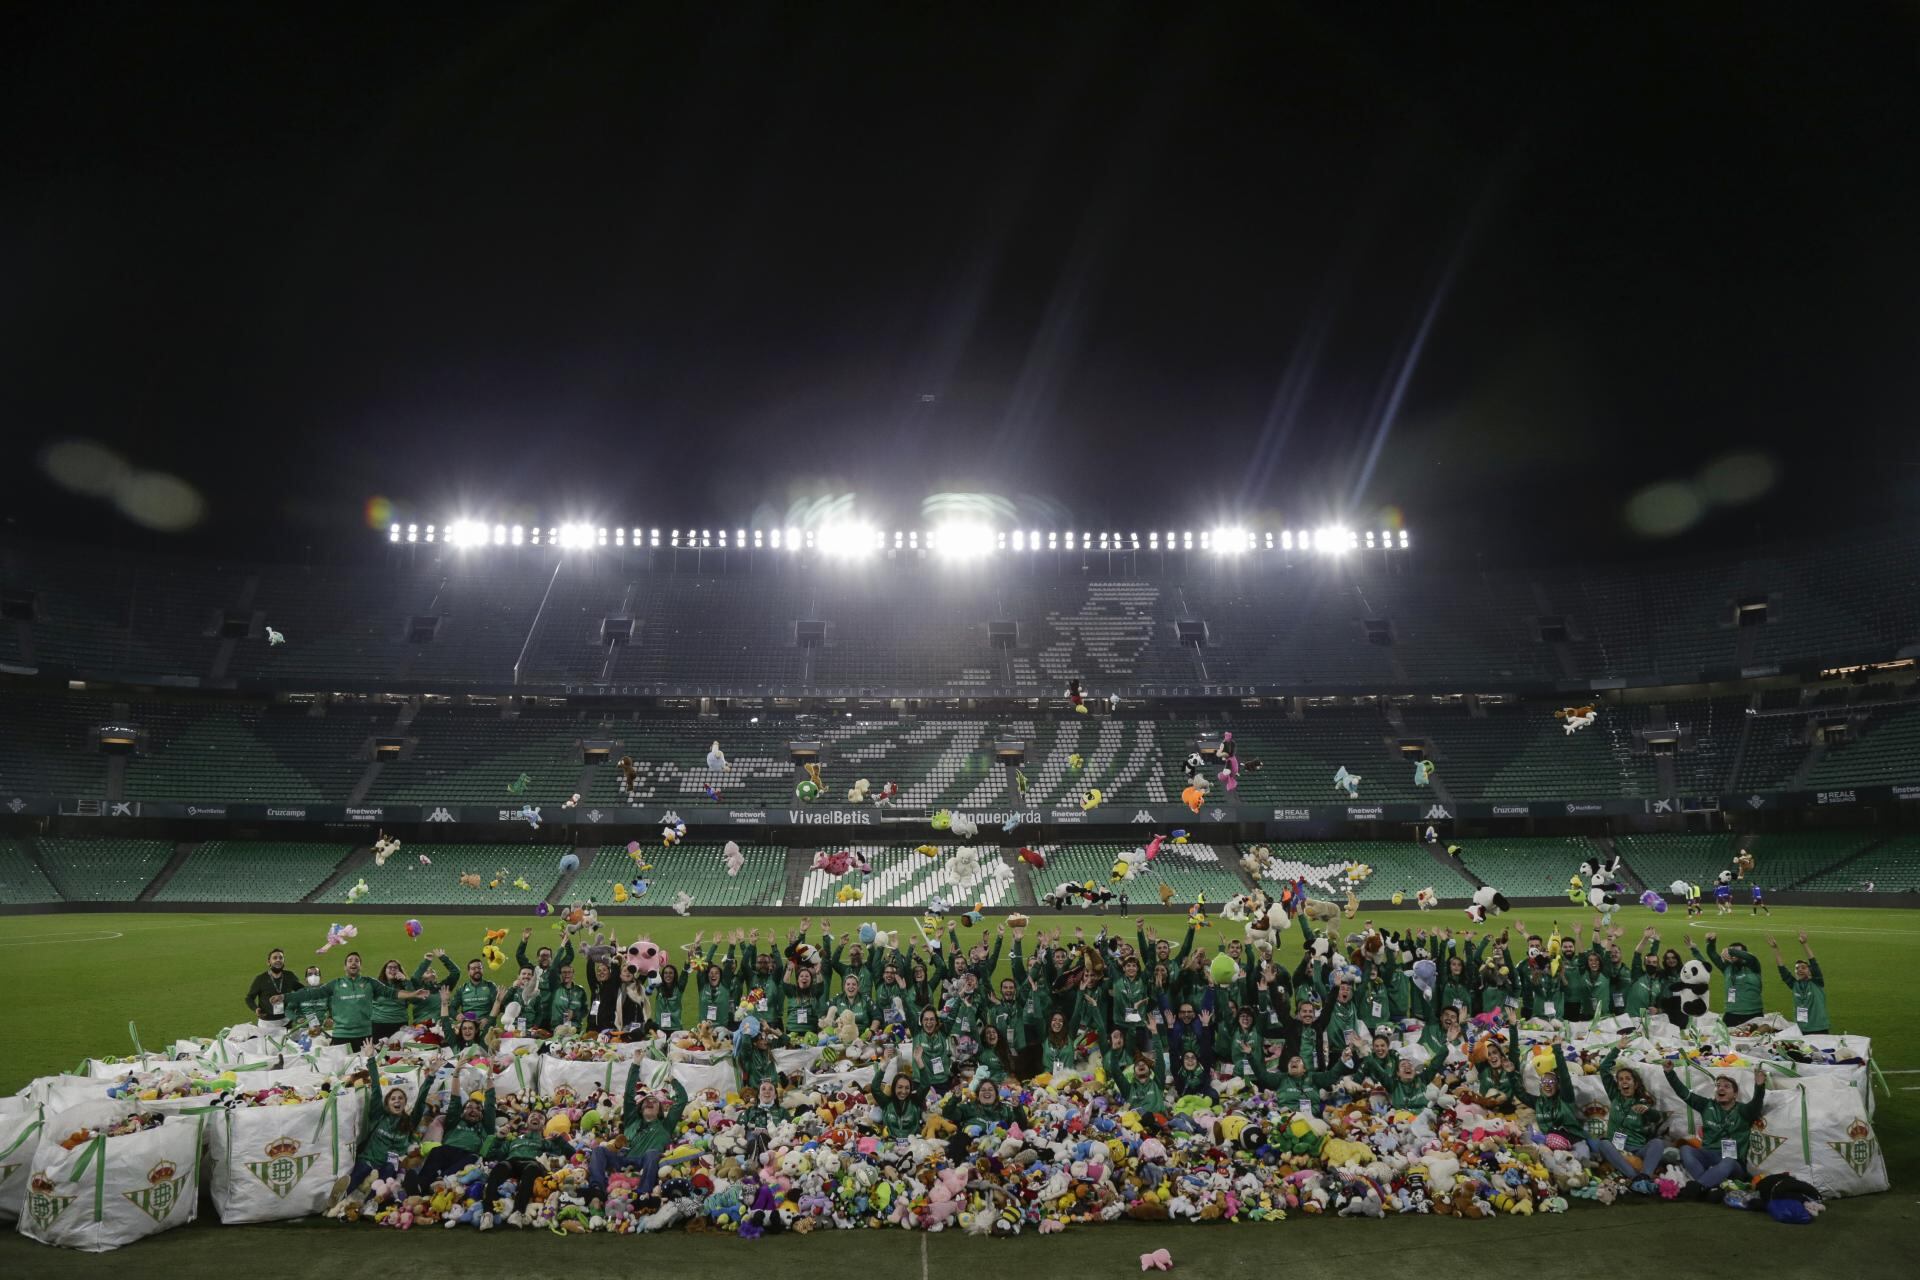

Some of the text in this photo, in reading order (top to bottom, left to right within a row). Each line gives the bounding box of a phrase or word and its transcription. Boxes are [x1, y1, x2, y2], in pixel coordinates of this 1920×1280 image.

[1204, 686, 1256, 695] BETIS
[267, 808, 305, 817] Cruzcampo
[346, 807, 383, 815] finetwork
[1348, 807, 1384, 815] finetwork
[1492, 806, 1530, 815] Cruzcampo
[789, 810, 871, 825] VivaelBetis
